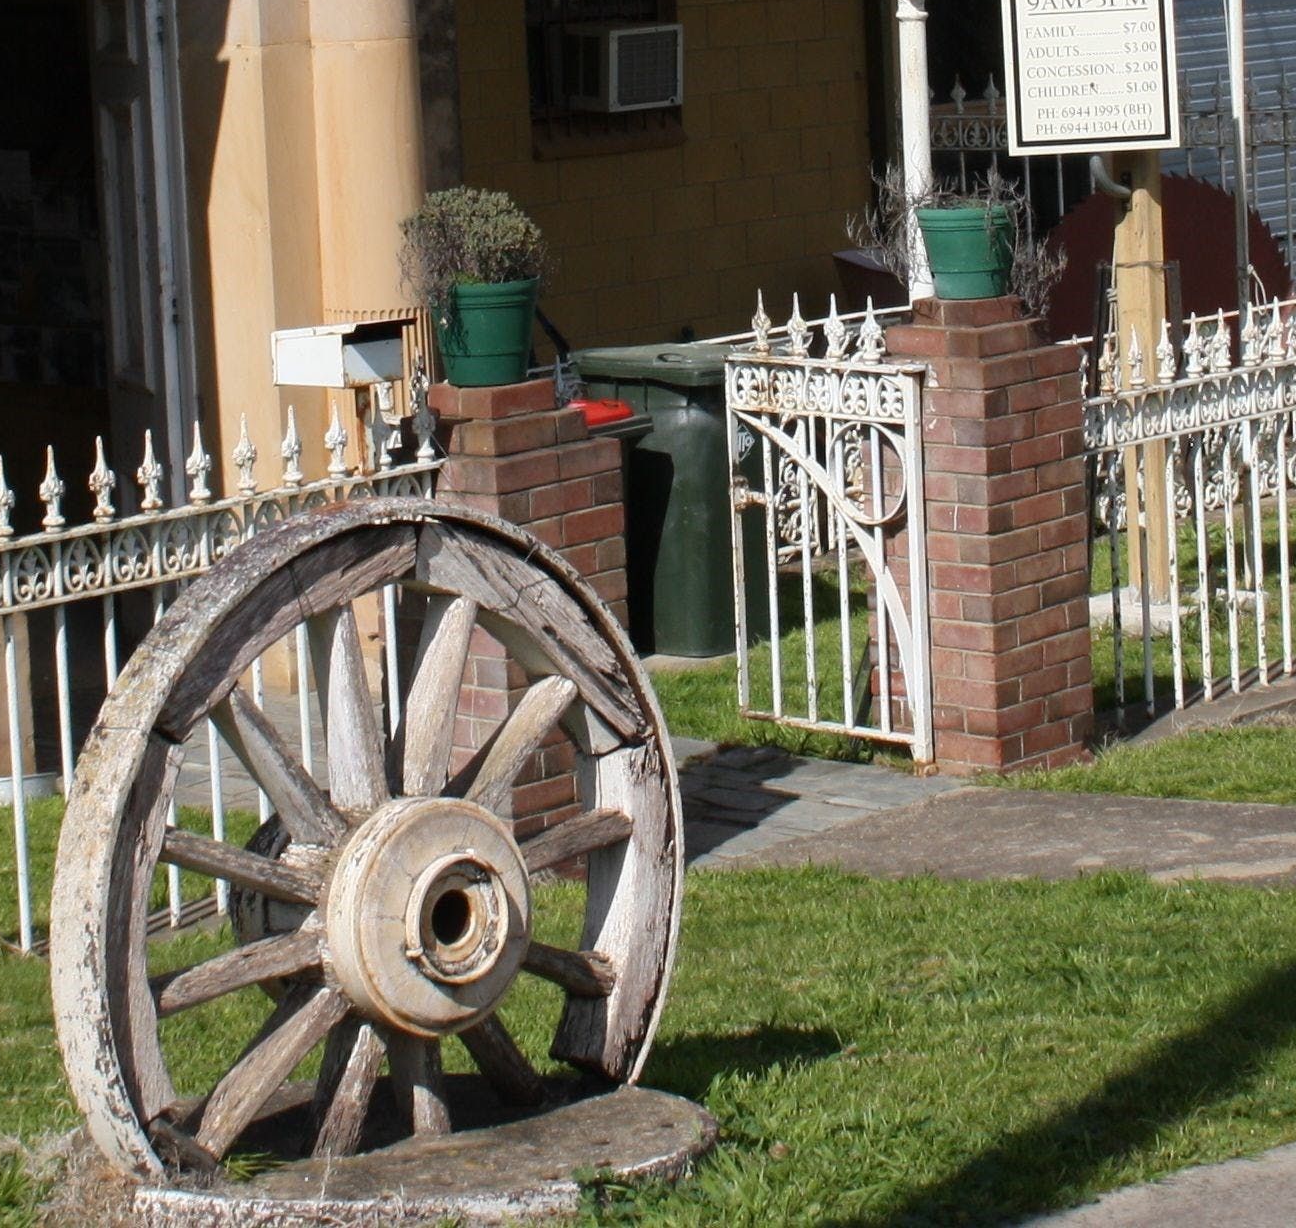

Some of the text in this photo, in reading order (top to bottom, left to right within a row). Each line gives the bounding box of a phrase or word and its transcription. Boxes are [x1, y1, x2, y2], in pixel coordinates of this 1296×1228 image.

[1123, 21, 1155, 34] $7.00
[1124, 41, 1157, 53] $3.00
[1037, 108, 1059, 119] PH:
[1061, 106, 1090, 118] 6944
[1123, 103, 1152, 117] (BH)
[1036, 124, 1057, 135] PH:
[1122, 119, 1152, 133] (AH)
